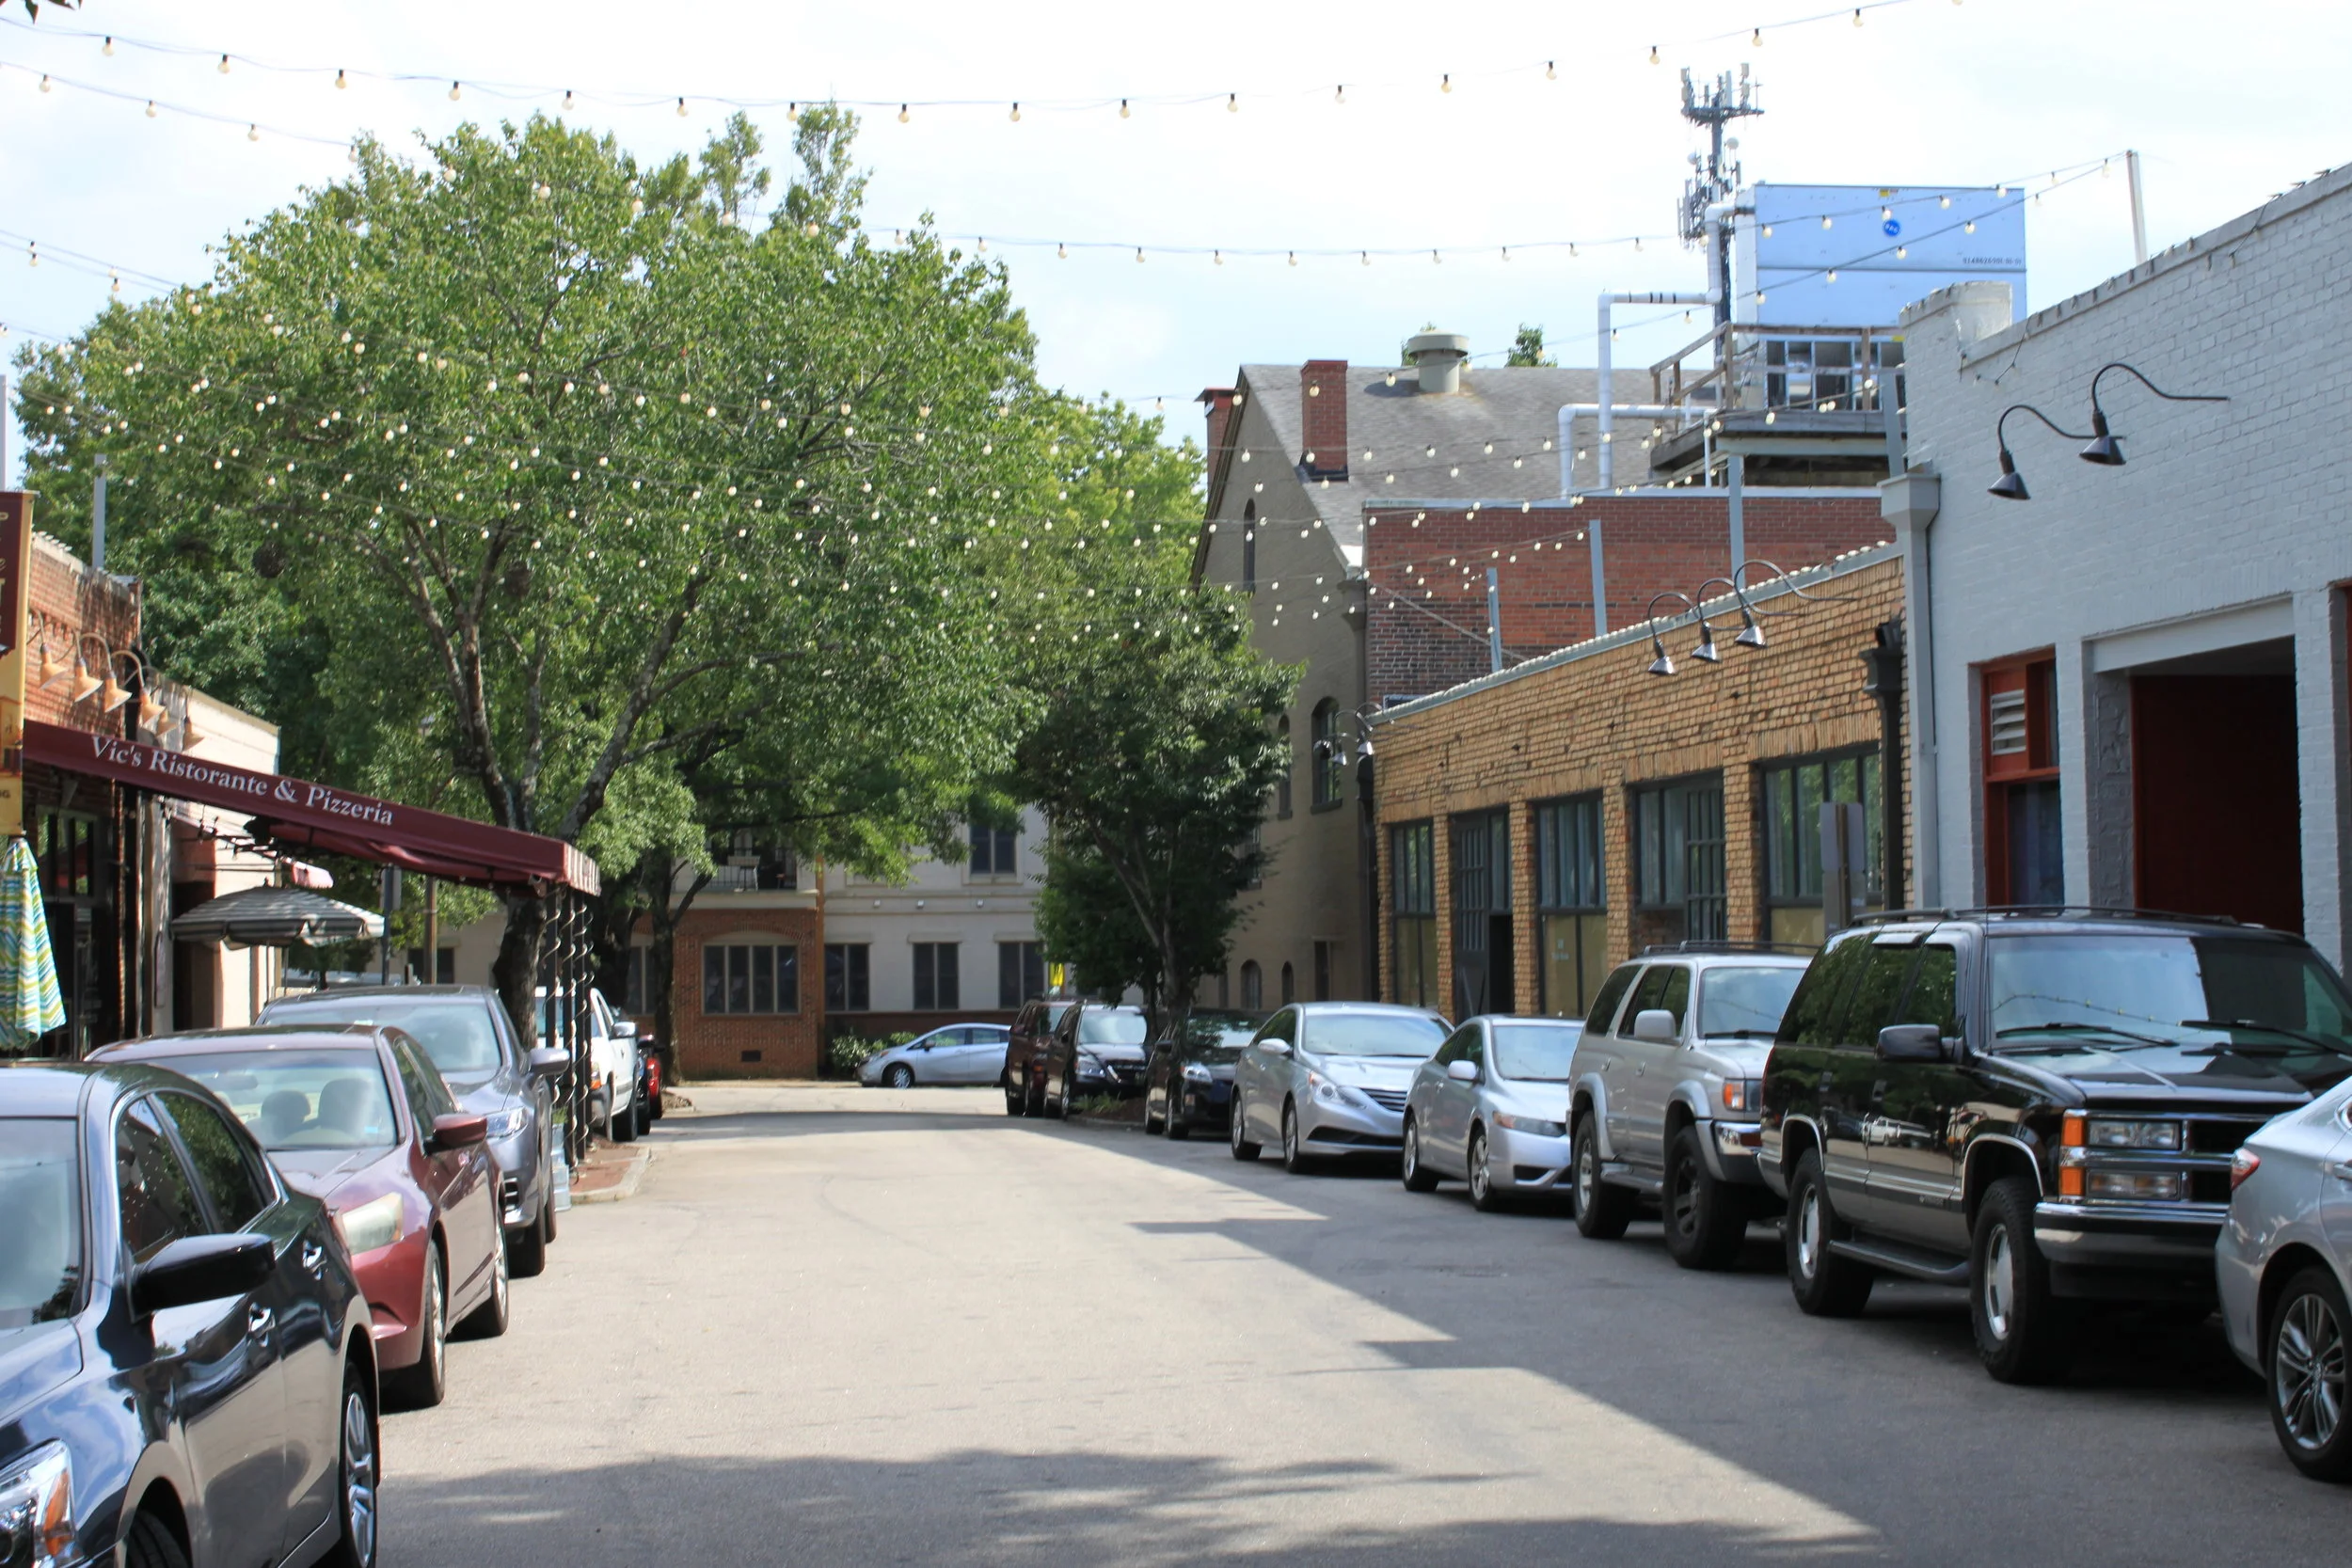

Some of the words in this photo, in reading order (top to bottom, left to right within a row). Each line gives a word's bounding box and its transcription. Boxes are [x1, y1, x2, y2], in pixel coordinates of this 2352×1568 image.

[91, 736, 141, 768] Vic's
[150, 751, 267, 796] Ristorante
[275, 780, 298, 803] &
[305, 786, 393, 826] Pizzeria
